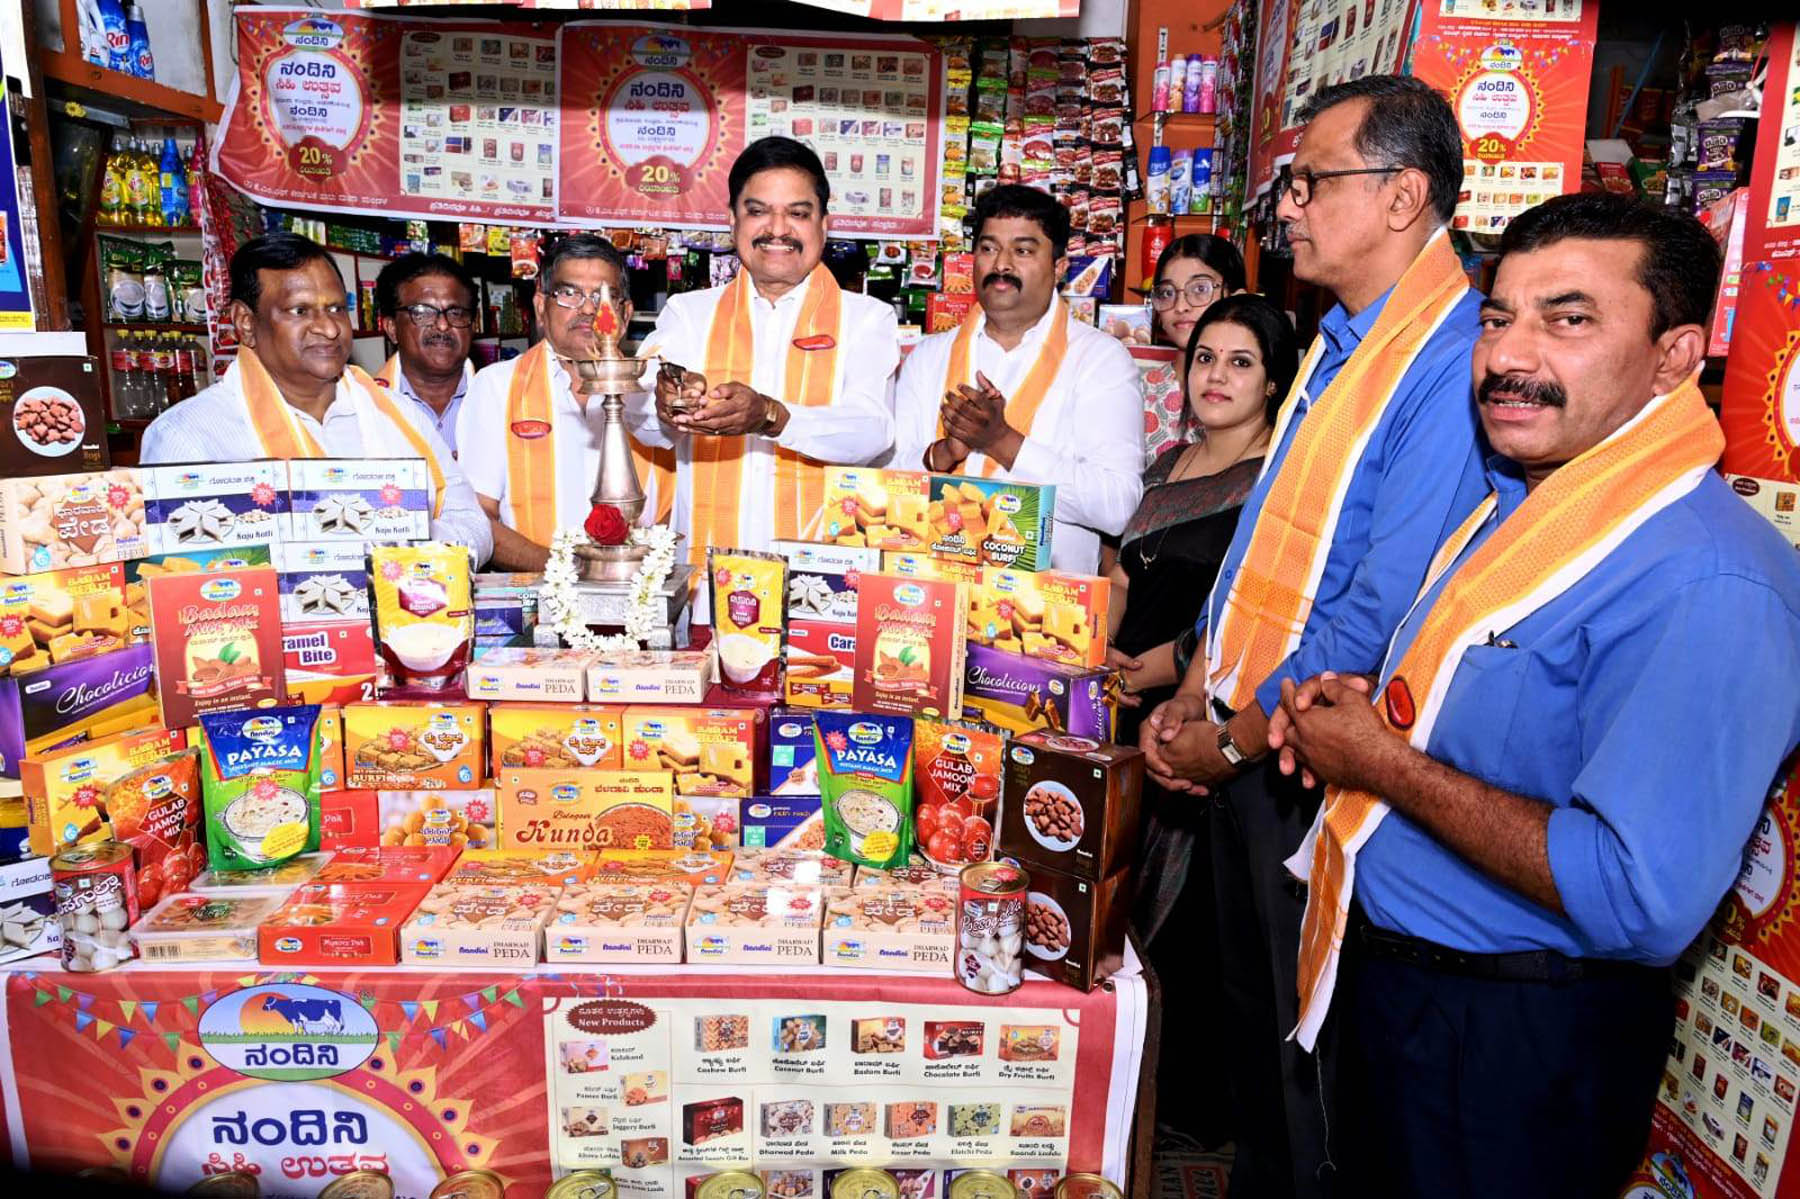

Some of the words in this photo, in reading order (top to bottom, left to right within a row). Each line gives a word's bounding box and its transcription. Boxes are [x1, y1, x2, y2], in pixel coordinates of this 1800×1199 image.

[106, 32, 129, 46] Rin
[295, 35, 329, 47] ನಂದಿನಿ
[140, 54, 152, 67] Rin
[645, 55, 678, 66] ನಂದಿನಿ
[281, 61, 336, 78] ನಂದಿನಿ
[630, 81, 685, 98] ನಂದಿನಿ
[1477, 80, 1515, 92] ನಂದಿನಿ
[289, 105, 328, 118] ನಂದಿನಿ
[637, 125, 676, 136] ನಂದಿನಿ
[236, 532, 254, 540] Kaju
[375, 527, 392, 536] Kaju
[983, 541, 1025, 555] COCONUT
[282, 635, 326, 650] ramel
[831, 636, 857, 650] Cara
[302, 649, 334, 664] Bite
[545, 684, 576, 694] PEDA
[665, 685, 696, 695] PEDA
[227, 745, 303, 766] PAYASA
[836, 750, 898, 769] PAYASA
[935, 758, 973, 775] GULAB
[930, 768, 976, 786] JAMOON
[943, 781, 962, 794] MIX
[148, 799, 185, 821] GULAB
[148, 808, 188, 833] JAMOON
[163, 824, 182, 838] MIX
[516, 819, 610, 843] Kunda
[47, 935, 60, 944] Ka
[493, 949, 531, 959] PEDA
[637, 945, 674, 955] PEDA
[776, 945, 814, 957] PEDA
[913, 951, 949, 963] PEDA
[578, 1018, 599, 1027] New
[602, 1018, 645, 1027] Products
[244, 1043, 340, 1070] ನಂದಿನಿ
[697, 1066, 726, 1074] Cashew
[805, 1067, 825, 1075] Burfi
[998, 1071, 1012, 1079] Dry
[212, 1109, 369, 1147] ನಂದಿನಿ
